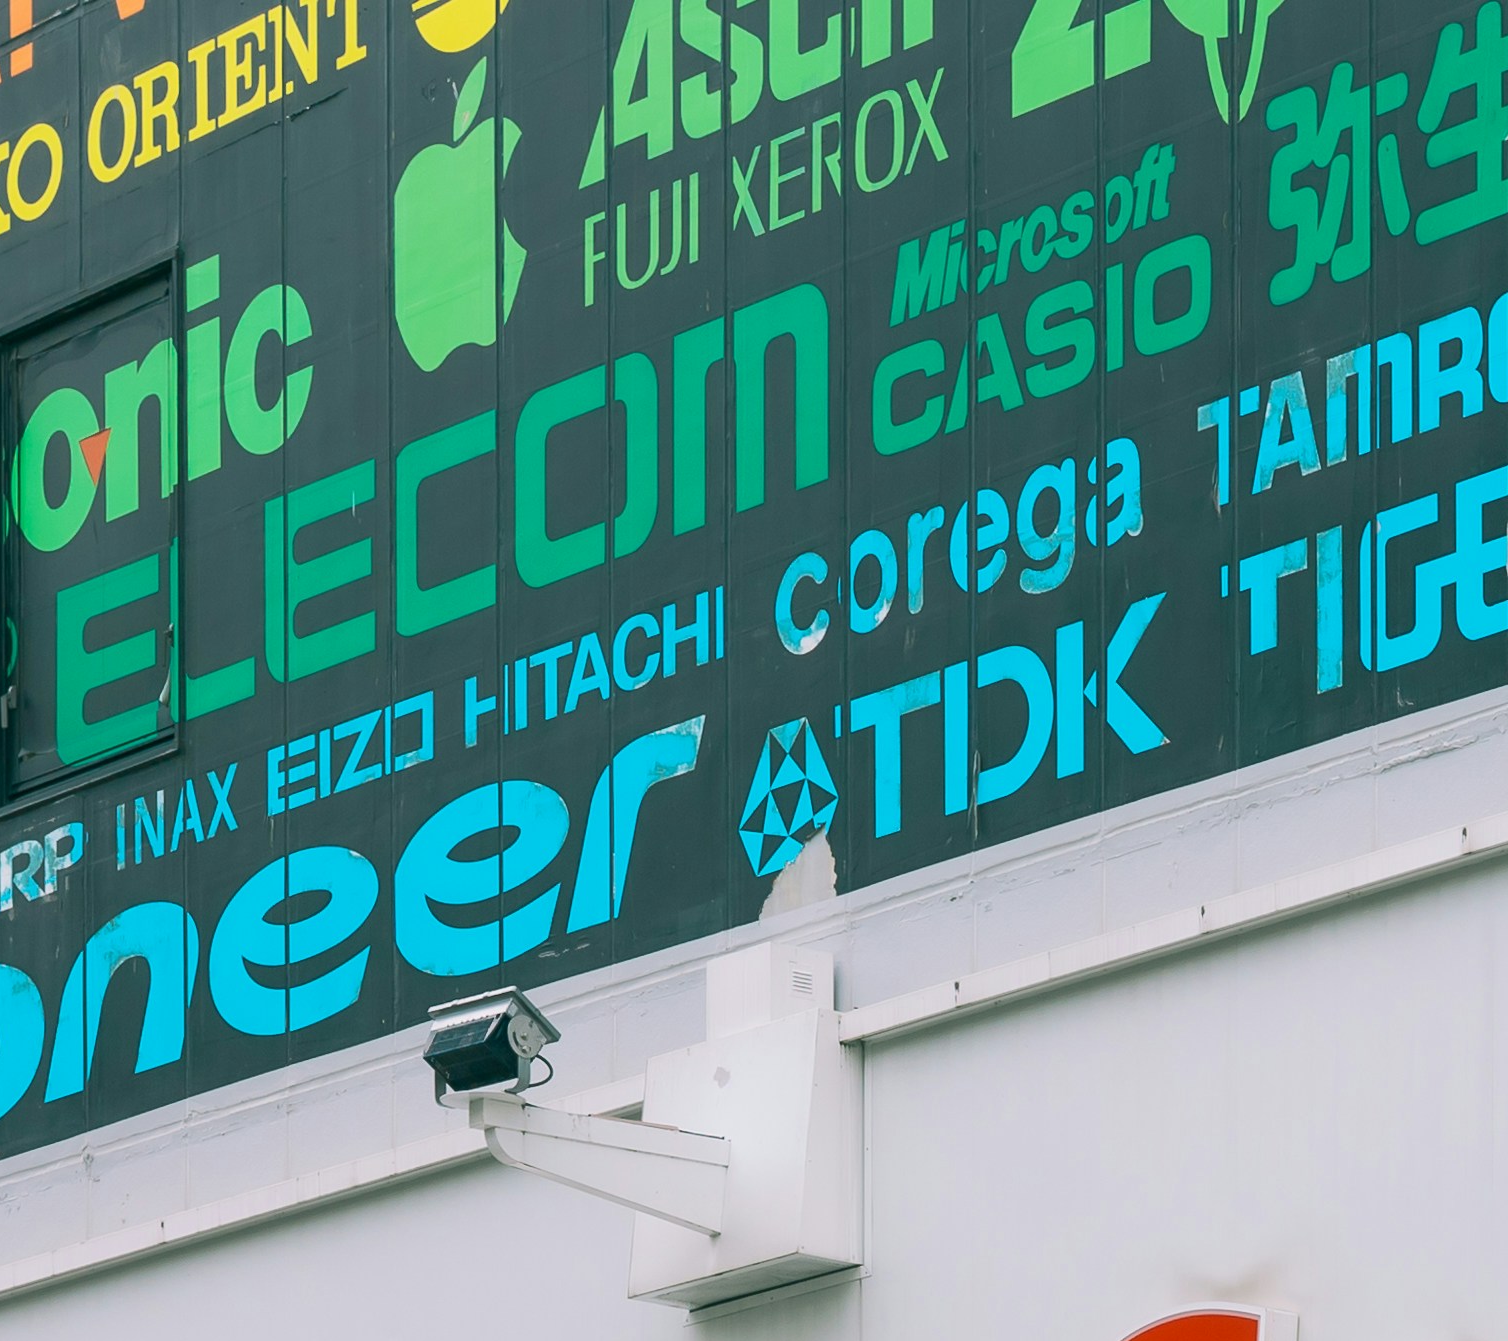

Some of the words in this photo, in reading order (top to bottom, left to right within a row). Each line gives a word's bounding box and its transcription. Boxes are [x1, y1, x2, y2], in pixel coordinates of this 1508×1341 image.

[87, 0, 370, 184] ORIENT
[584, 172, 699, 307] FUJI
[732, 68, 949, 238] XEROX
[871, 234, 1212, 456] CASIO
[891, 143, 1176, 328] Microsoft
[775, 437, 1144, 655] corega
[114, 763, 240, 871] INAX
[267, 690, 433, 818] EIZO
[465, 586, 725, 748] HITACHI
[835, 592, 1170, 838] TDK
